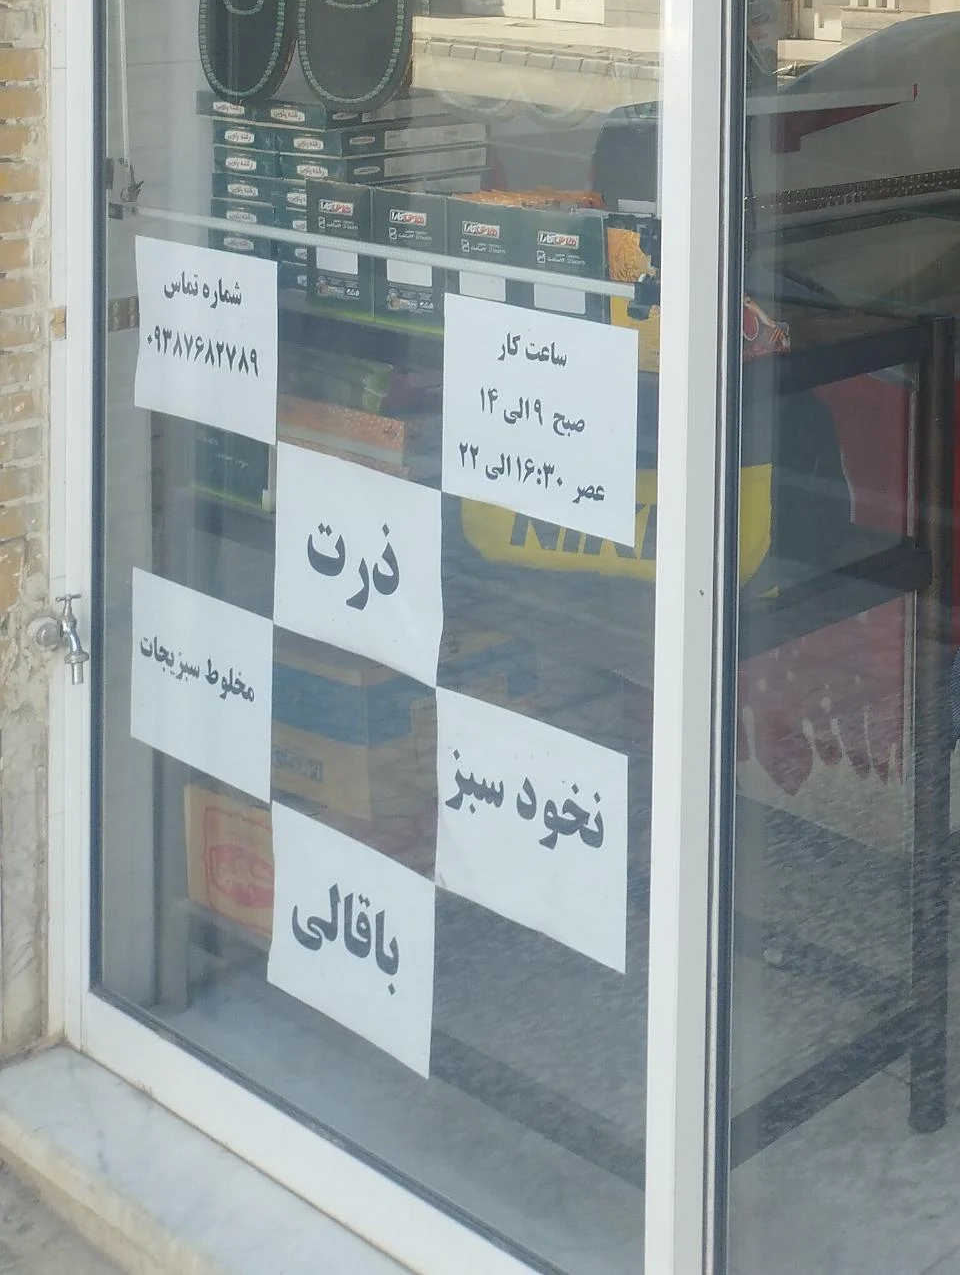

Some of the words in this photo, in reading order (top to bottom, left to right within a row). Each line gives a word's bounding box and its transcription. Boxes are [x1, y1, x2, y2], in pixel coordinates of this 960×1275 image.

[163, 271, 199, 299] تماس
[202, 278, 242, 309] شماره
[147, 325, 259, 377] ۰۹۳۸۷۶۸۲۷۸۹
[497, 331, 521, 361] کار
[525, 338, 567, 367] ساعت
[480, 387, 499, 414] ۱۴
[552, 412, 585, 436] صبح
[459, 442, 479, 470] ۲۲
[572, 485, 605, 504] عصر
[307, 522, 400, 612] ذرت
[139, 636, 200, 682] سبزیجات
[203, 657, 255, 704] مخلوط
[445, 749, 505, 815] سبز
[516, 777, 605, 850] نخود
[291, 882, 400, 994] باقالی
